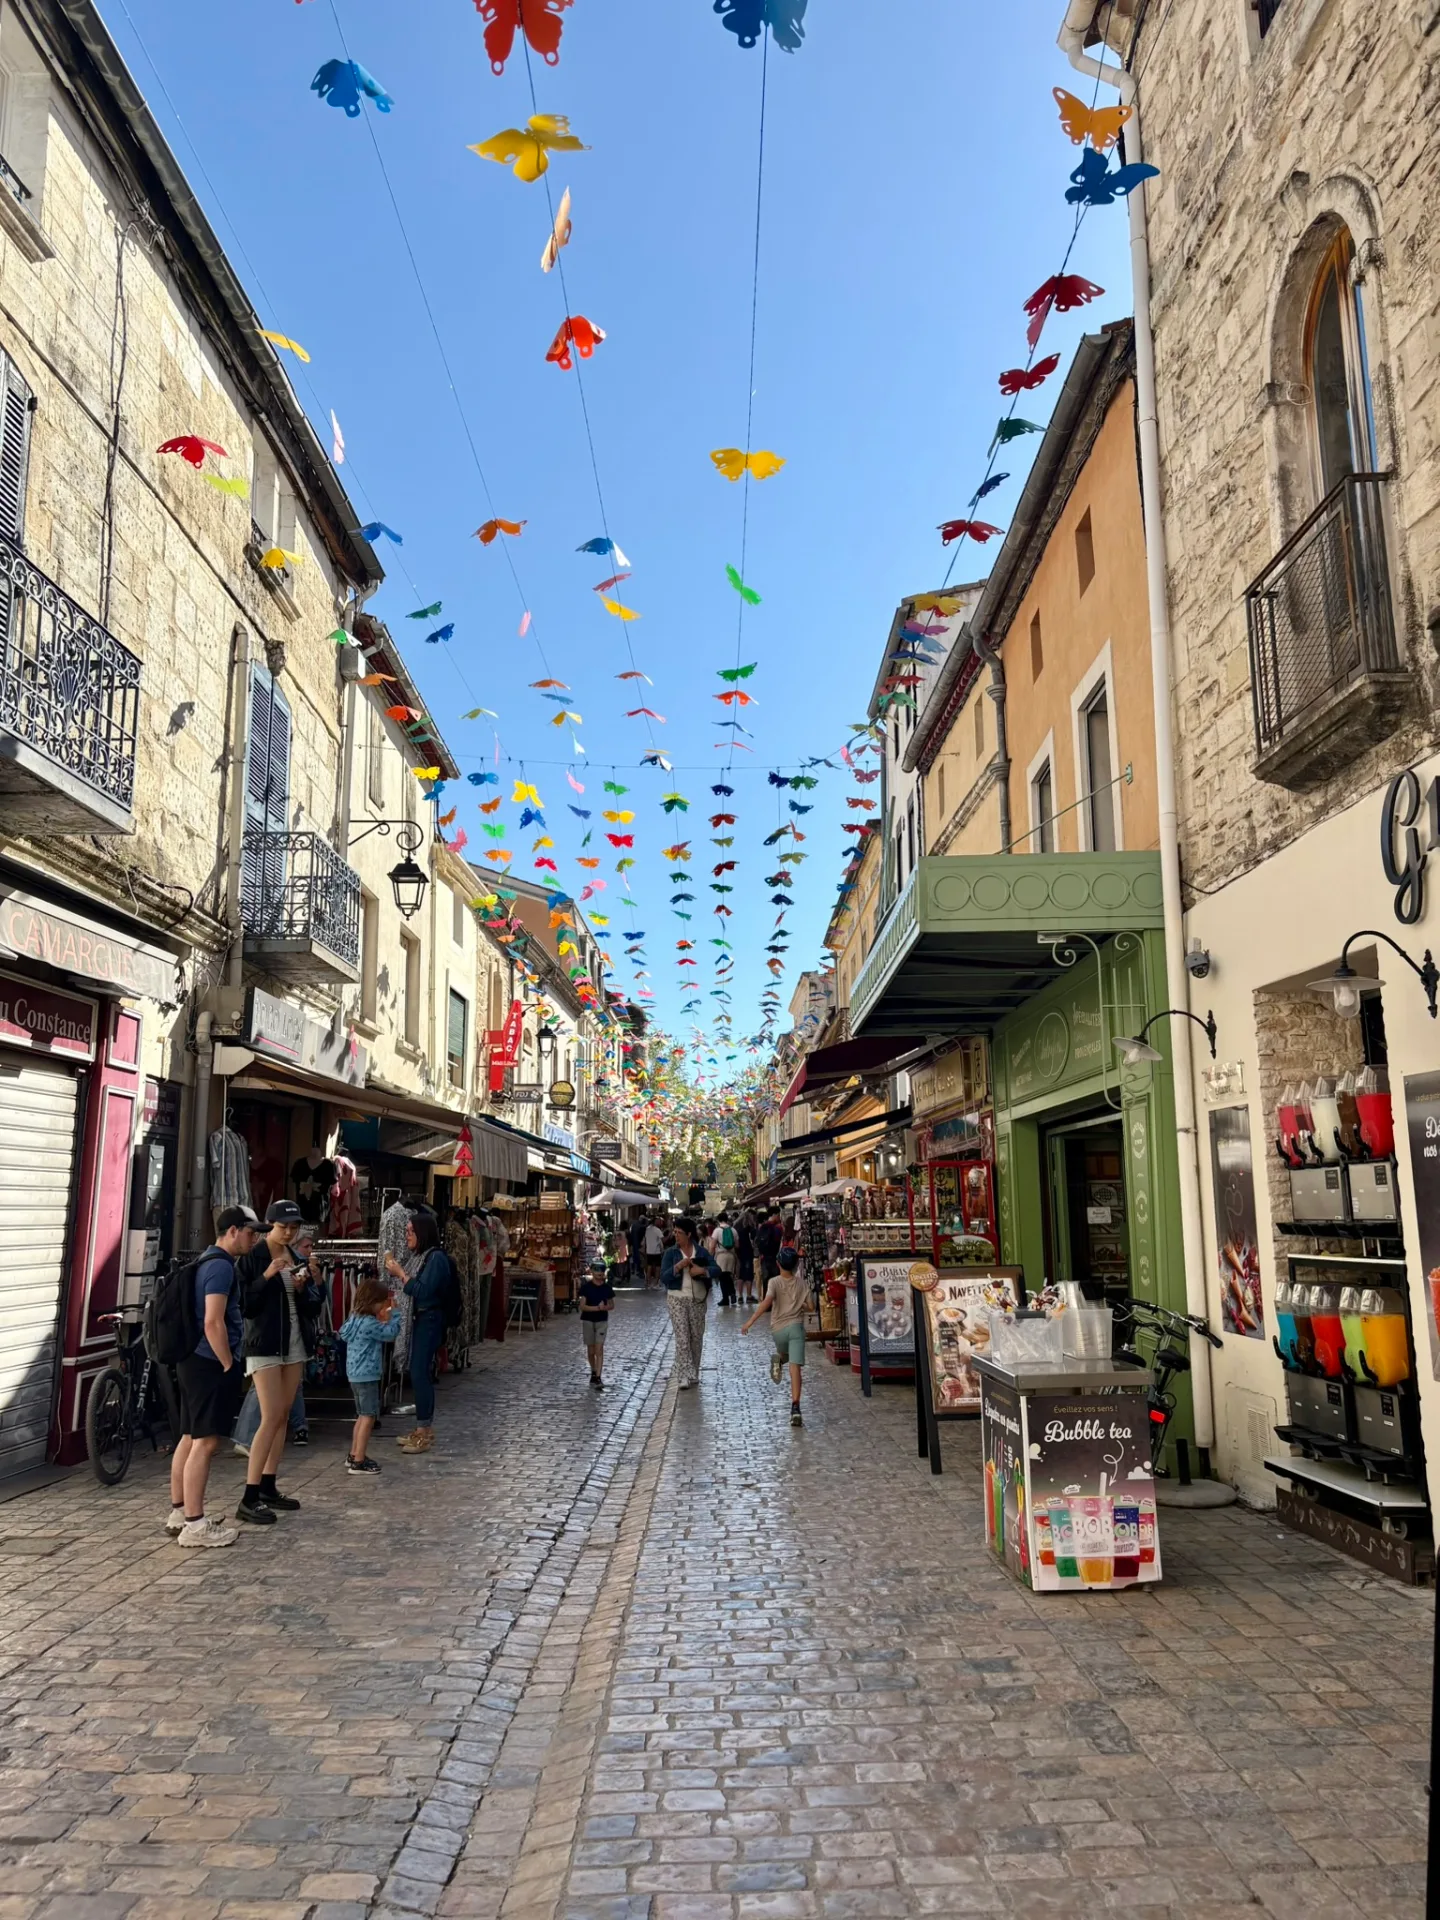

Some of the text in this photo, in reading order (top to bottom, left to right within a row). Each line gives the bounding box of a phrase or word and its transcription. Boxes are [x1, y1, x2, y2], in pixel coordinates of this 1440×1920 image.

[9, 911, 137, 988] CAMARGUE
[14, 998, 91, 1043] Constance
[506, 1012, 518, 1053] TABAC
[136, 1359, 151, 1409] OCUS
[1053, 1405, 1082, 1414] Éveillez
[1044, 1419, 1133, 1442] Bubble tea
[1052, 1524, 1073, 1540] BO
[1072, 1516, 1114, 1539] BOB
[1114, 1522, 1138, 1538] OB
